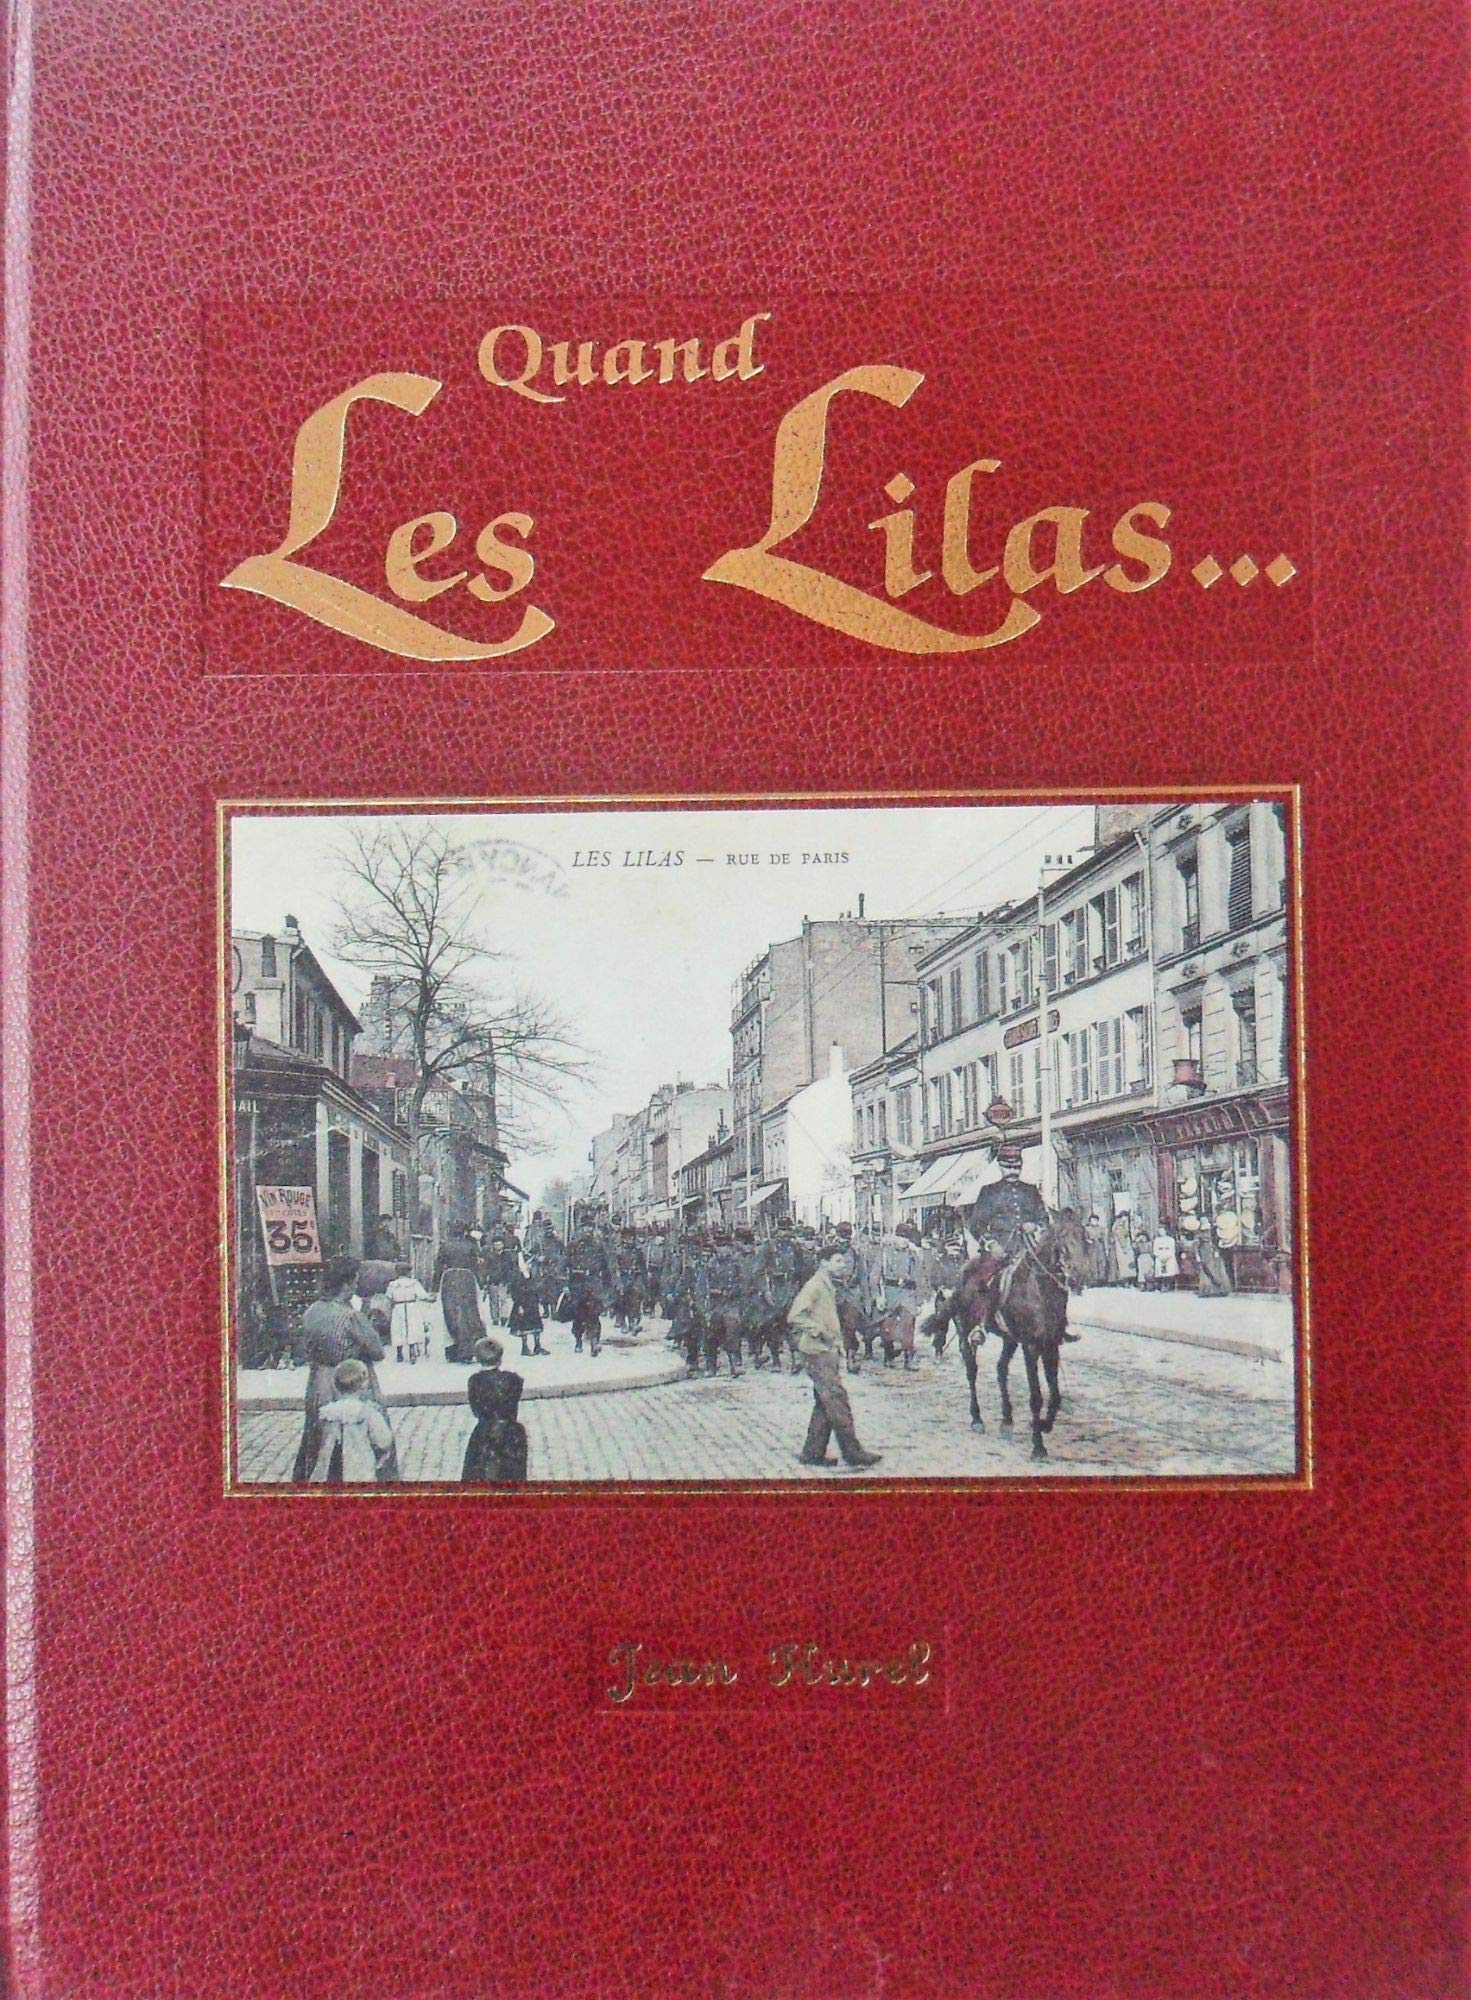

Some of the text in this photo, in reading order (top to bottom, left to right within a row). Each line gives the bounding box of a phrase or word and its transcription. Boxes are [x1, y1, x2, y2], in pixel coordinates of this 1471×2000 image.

[477, 312, 771, 403] Quand
[220, 371, 555, 662] Les
[572, 850, 612, 867] LES
[623, 850, 685, 867] LILAS
[727, 853, 760, 866] RUE
[769, 853, 791, 866] DE
[802, 852, 850, 865] PARIS
[607, 1643, 738, 1703] Jean
